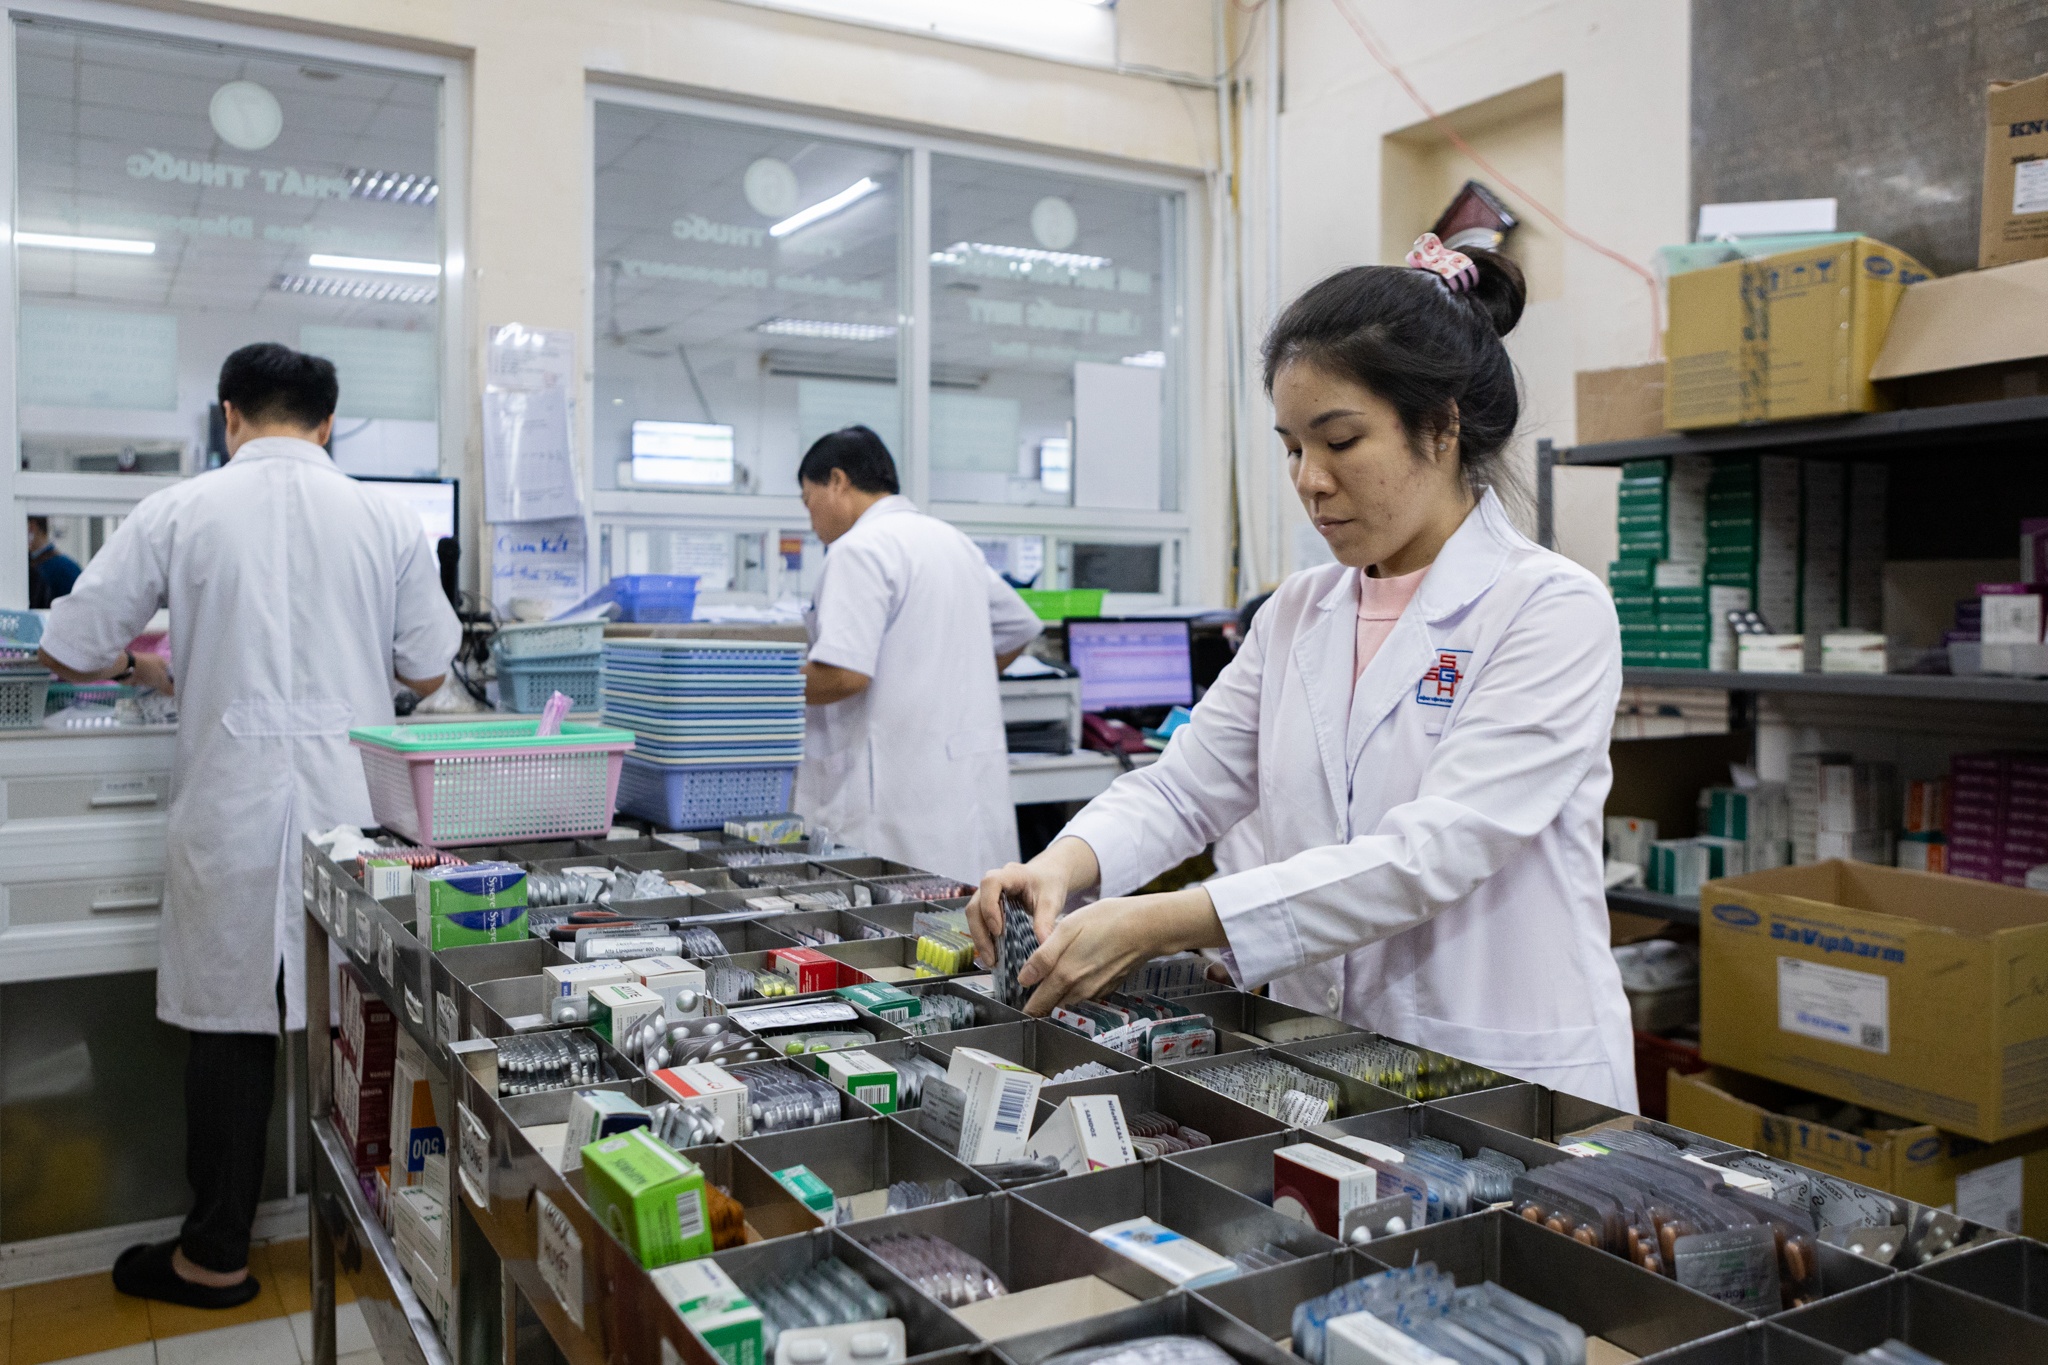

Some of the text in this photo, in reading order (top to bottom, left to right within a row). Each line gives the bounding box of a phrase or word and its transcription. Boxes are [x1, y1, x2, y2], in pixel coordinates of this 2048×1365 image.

[2009, 119, 2048, 138] KN
[487, 876, 498, 908] Syseye
[487, 911, 499, 943] Syseye
[1770, 922, 1906, 964] SaVipharm
[1084, 1109, 1097, 1138] SANDOZ
